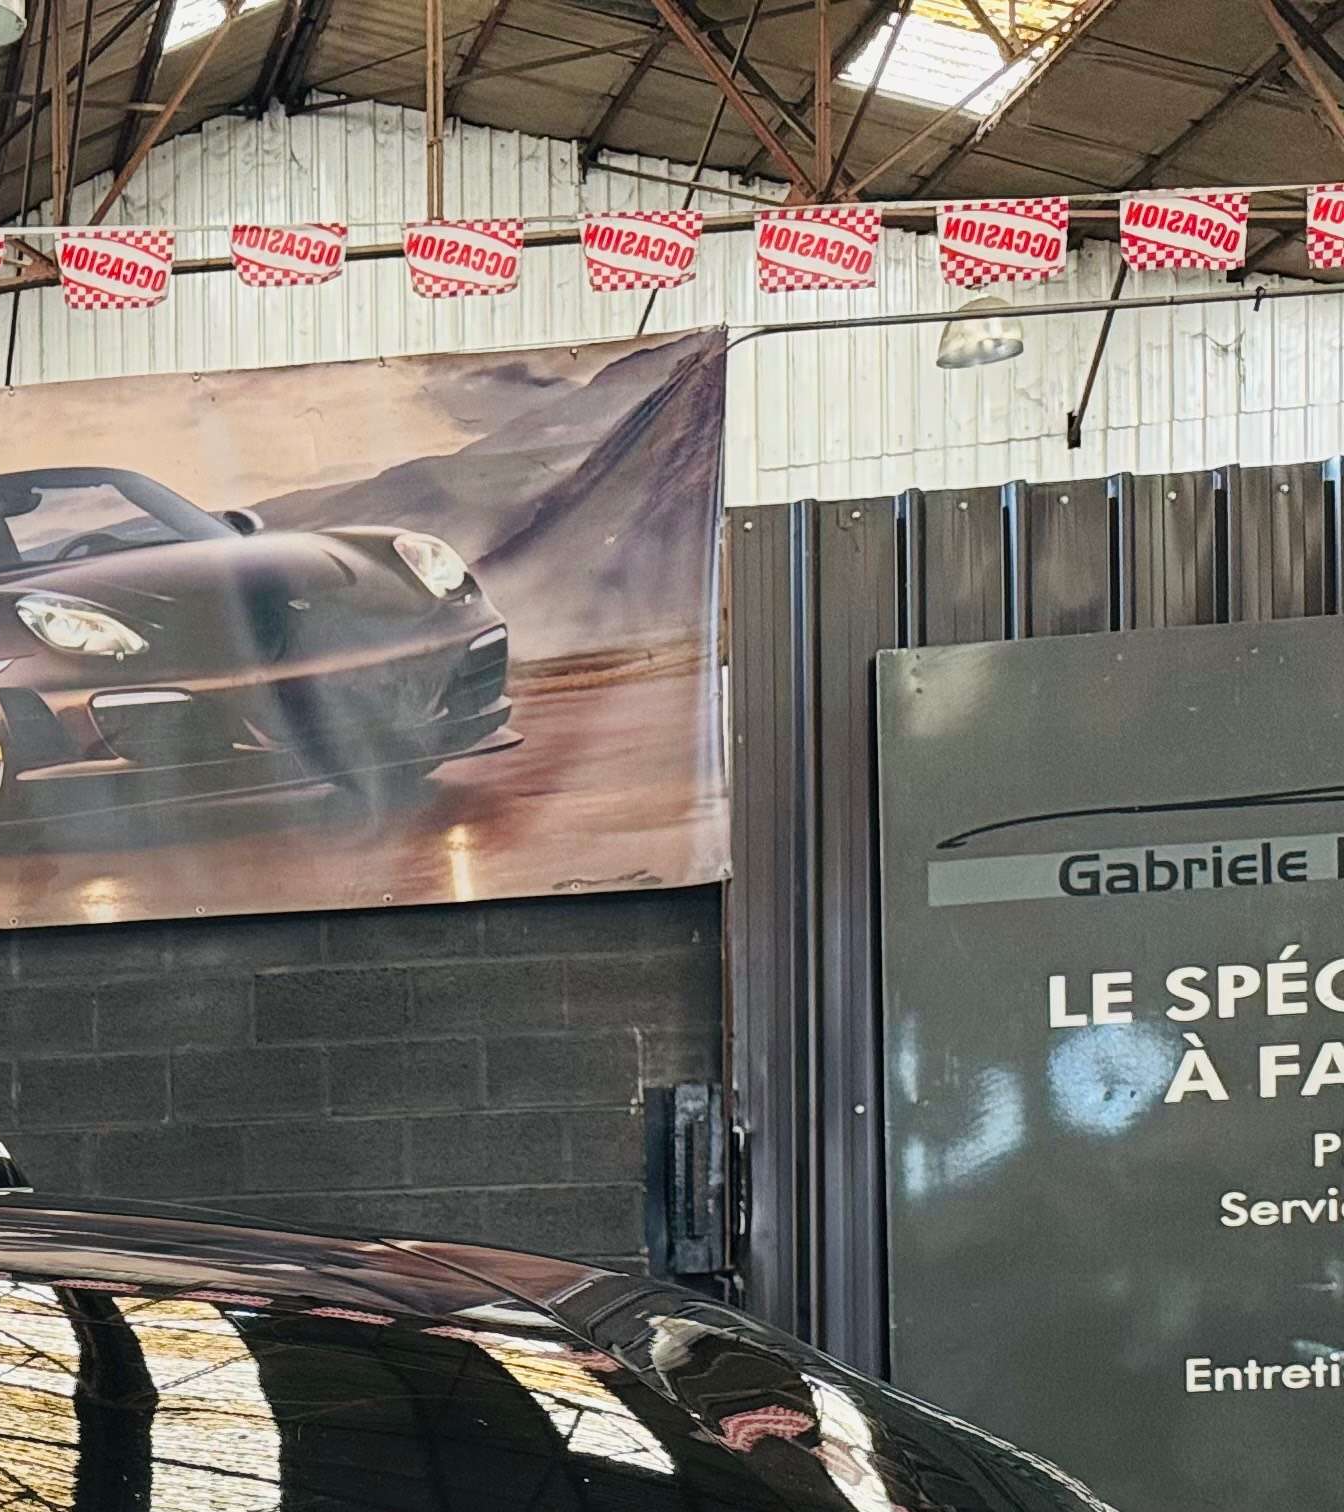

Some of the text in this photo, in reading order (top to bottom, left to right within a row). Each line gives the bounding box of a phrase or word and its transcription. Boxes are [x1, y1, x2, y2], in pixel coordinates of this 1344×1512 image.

[1058, 842, 1308, 896] Gabriele
[1049, 971, 1133, 1028] LE
[1164, 1032, 1230, 1103] À
[1220, 1187, 1344, 1227] Servi
